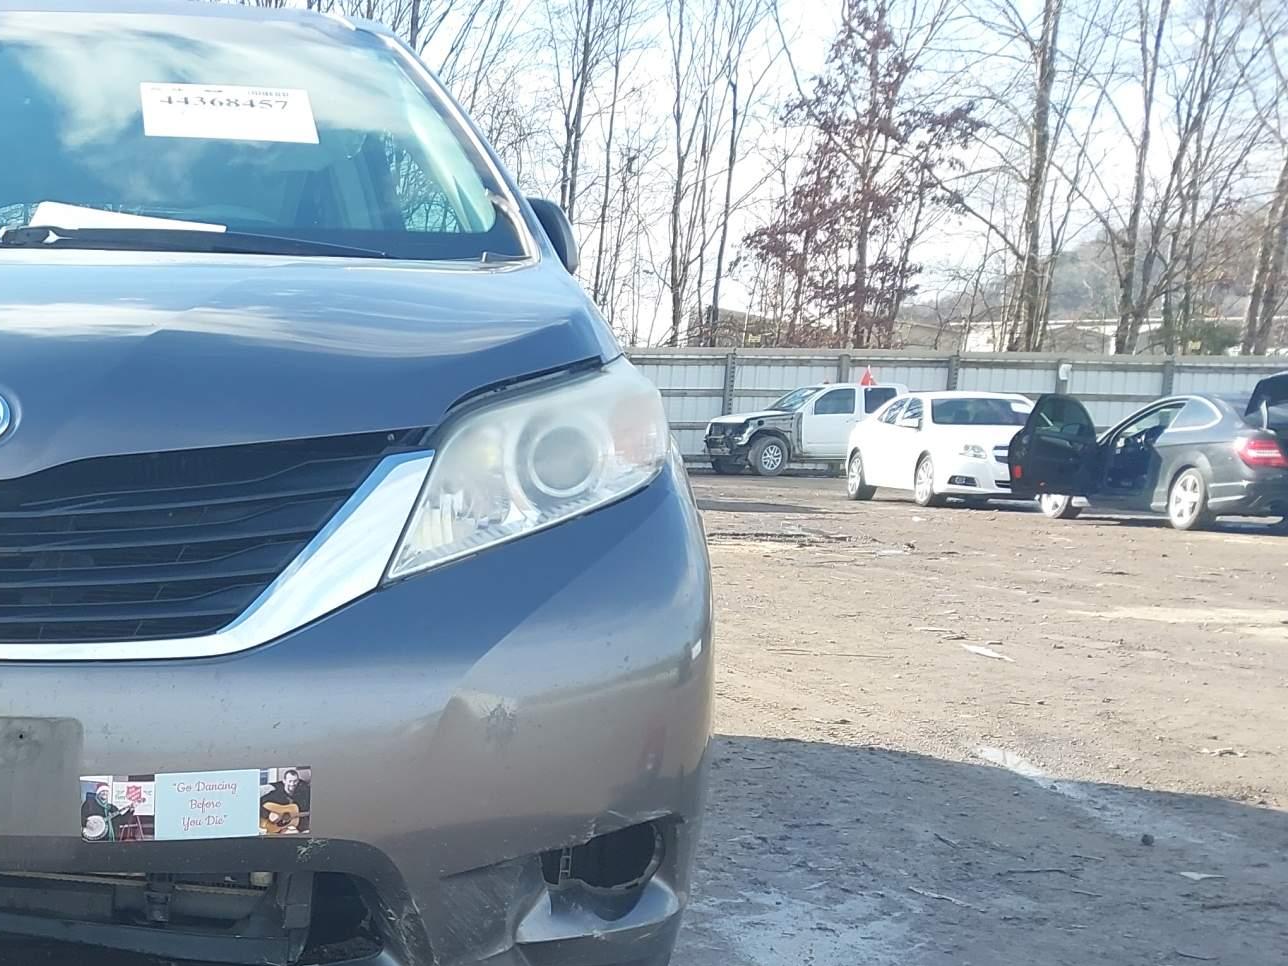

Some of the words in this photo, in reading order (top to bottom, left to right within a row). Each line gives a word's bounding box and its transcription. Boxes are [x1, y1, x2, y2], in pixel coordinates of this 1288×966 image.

[159, 95, 289, 110] 44368457
[196, 780, 237, 795] Dancing
[189, 798, 222, 813] Before
[182, 816, 202, 831] You
